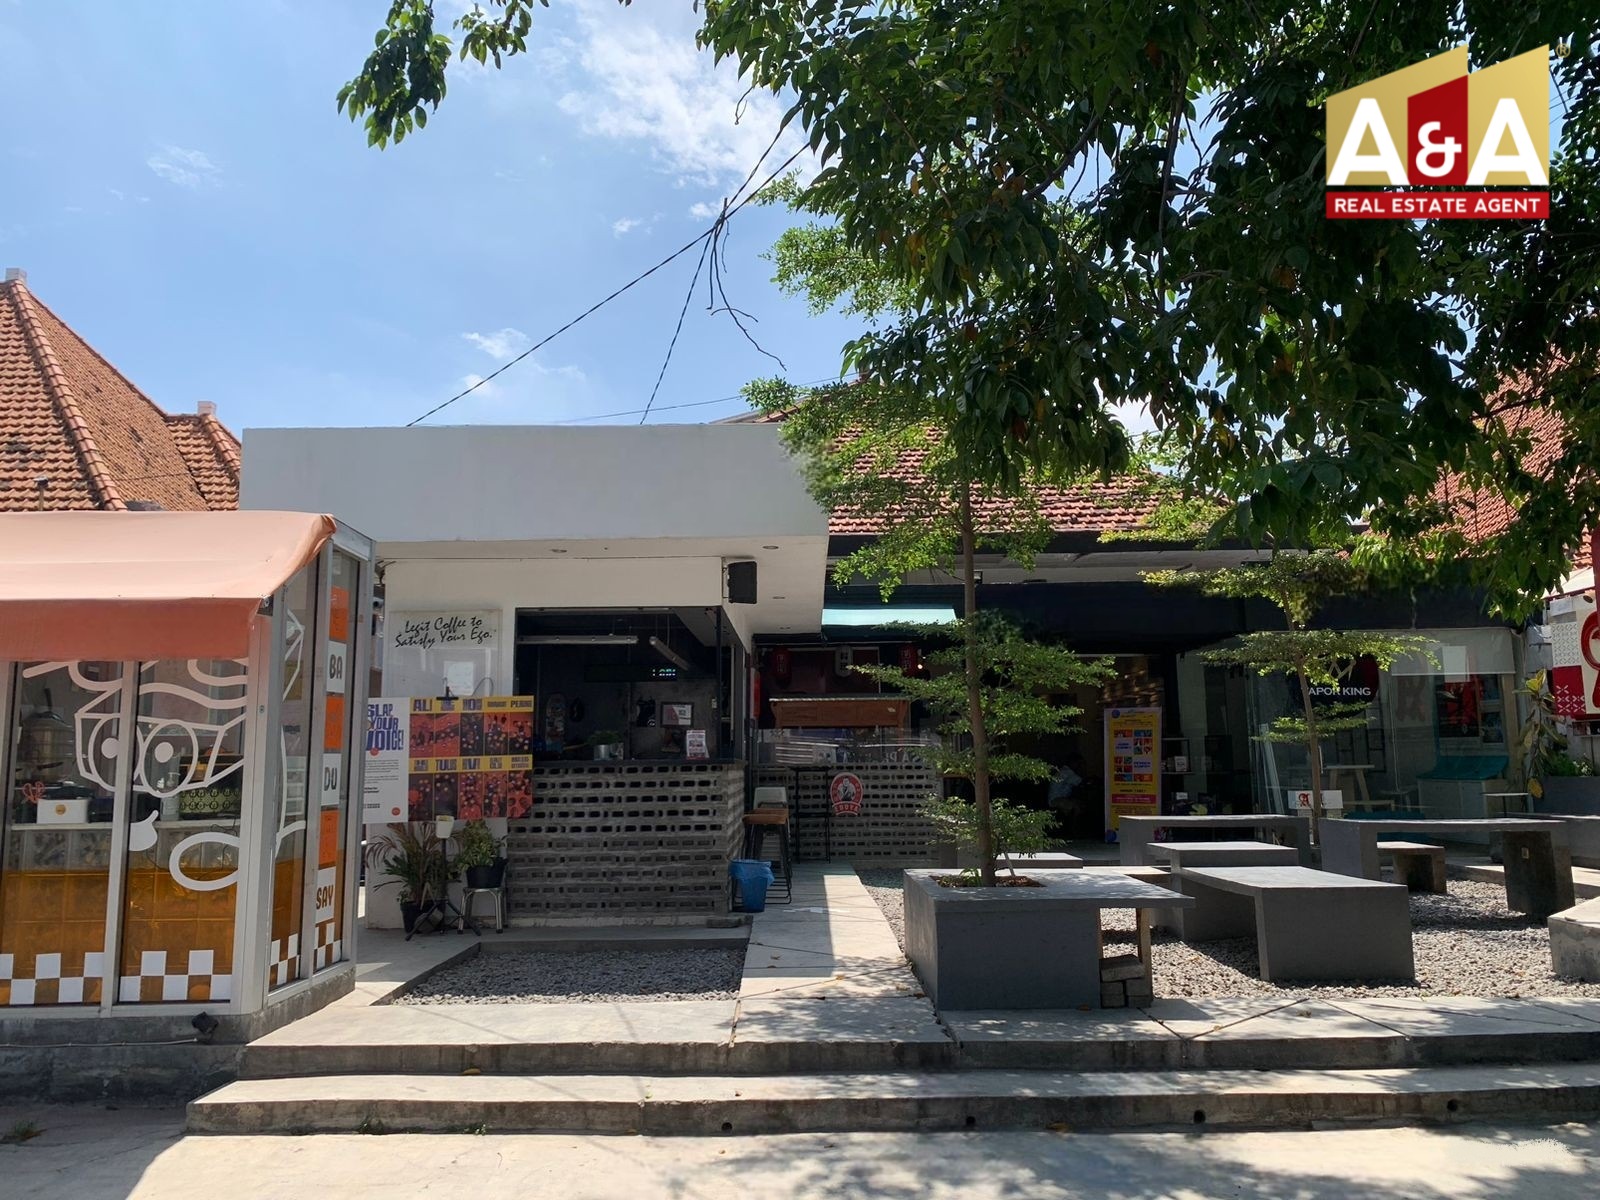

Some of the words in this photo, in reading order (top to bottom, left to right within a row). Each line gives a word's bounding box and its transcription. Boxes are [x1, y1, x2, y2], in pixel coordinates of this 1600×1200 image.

[395, 632, 435, 650] Satisfy
[440, 630, 466, 643] Your
[470, 626, 493, 645] Ego.
[405, 620, 431, 638] Legit
[434, 616, 466, 634] Coffee
[471, 616, 483, 627] to
[329, 654, 343, 680] BA
[1302, 687, 1341, 696] APOR
[1342, 687, 1372, 696] KING
[370, 716, 399, 730] YOUR
[324, 767, 338, 791] DU
[315, 884, 334, 910] SAY
